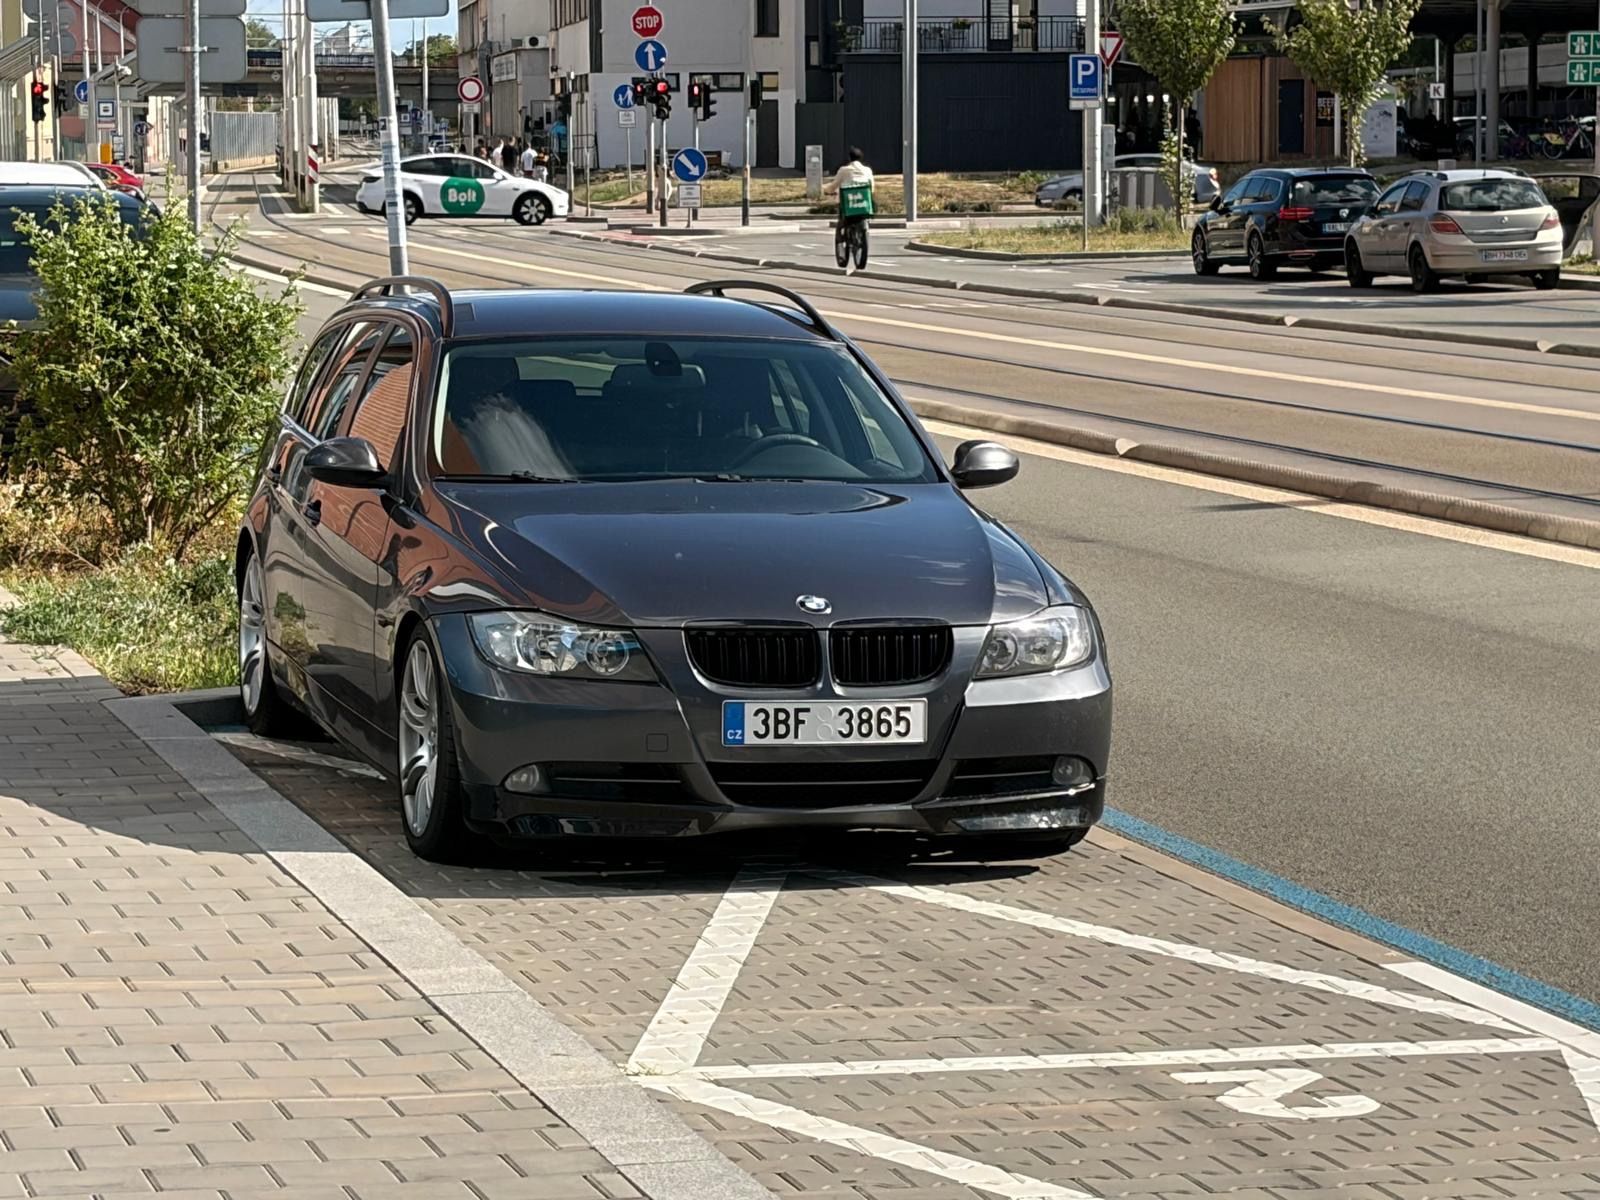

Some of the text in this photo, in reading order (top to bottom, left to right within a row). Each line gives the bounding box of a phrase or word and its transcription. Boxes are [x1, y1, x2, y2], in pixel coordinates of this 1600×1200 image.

[635, 15, 659, 29] STOP
[1077, 60, 1095, 85] P
[1432, 86, 1441, 97] K
[447, 187, 477, 206] Bolt
[753, 706, 912, 739] 3BF 3865
[727, 729, 742, 740] CZ
